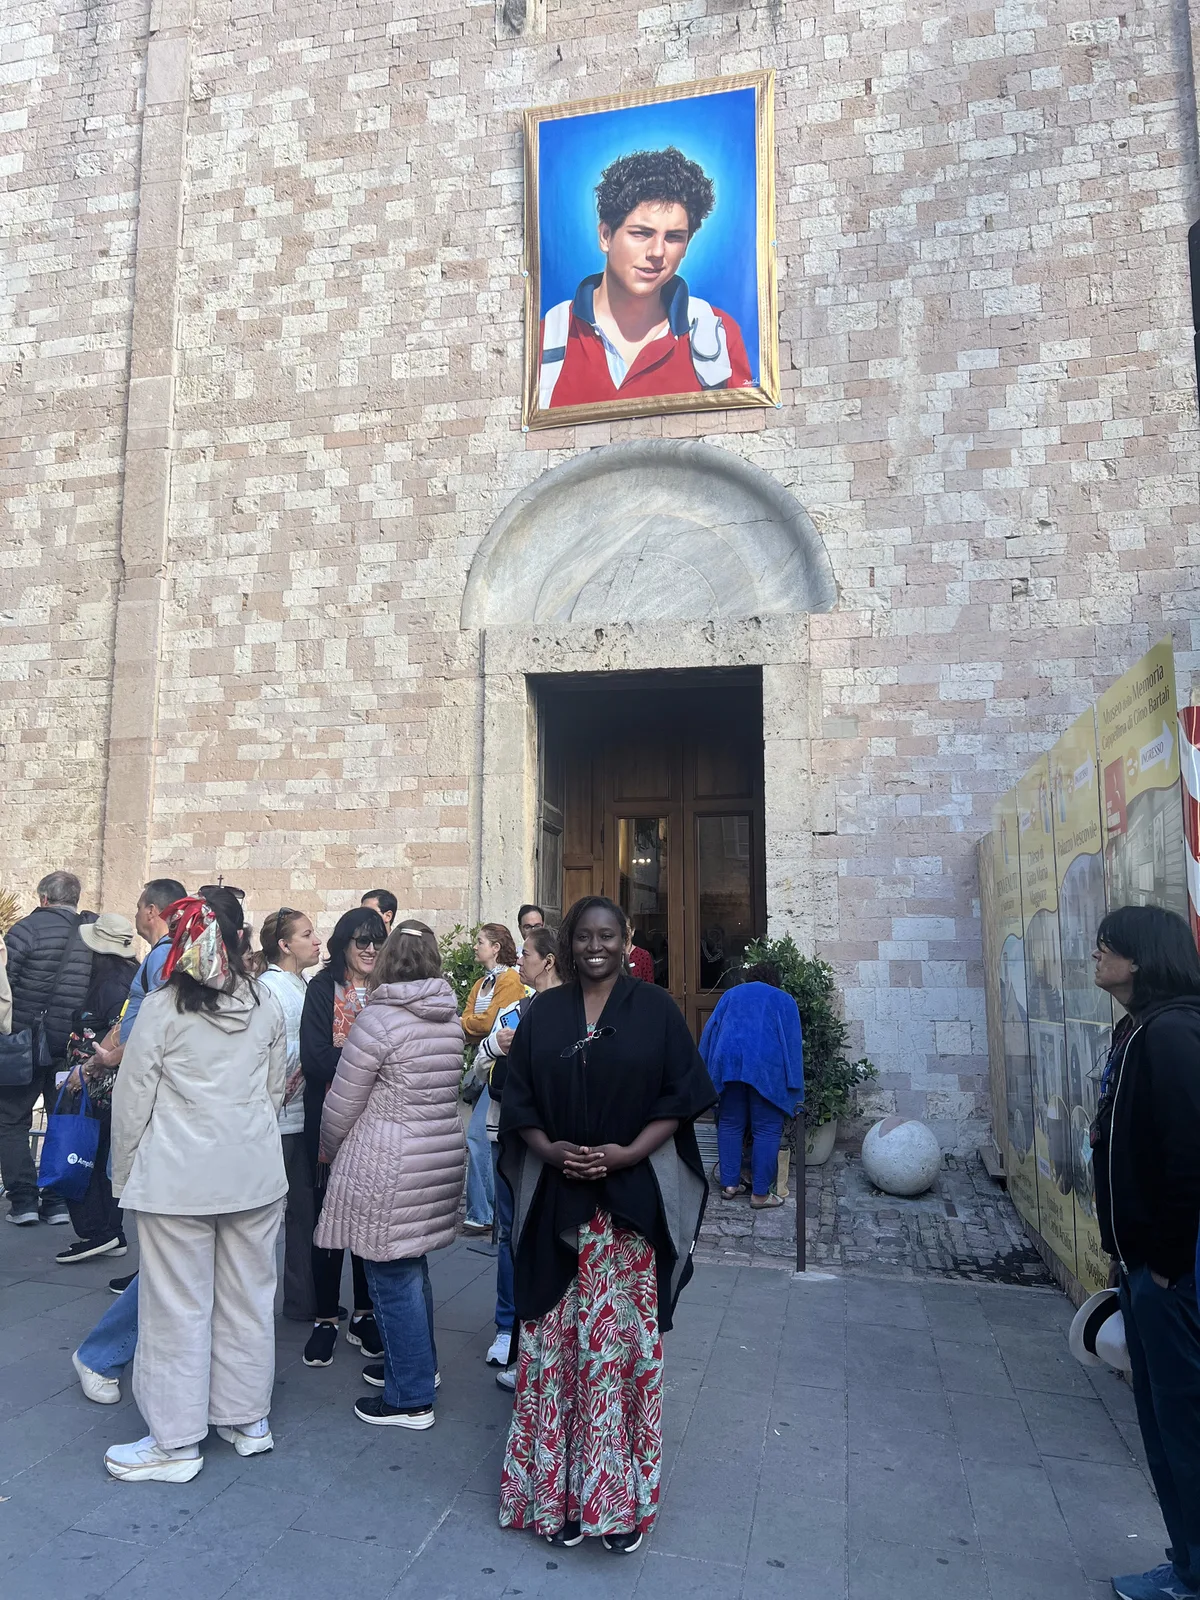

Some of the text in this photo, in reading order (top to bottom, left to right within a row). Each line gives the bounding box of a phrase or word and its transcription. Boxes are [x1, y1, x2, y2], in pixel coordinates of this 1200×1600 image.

[1103, 701, 1121, 725] Museo
[1132, 664, 1164, 701] Memoria
[1148, 684, 1170, 714] Bartali
